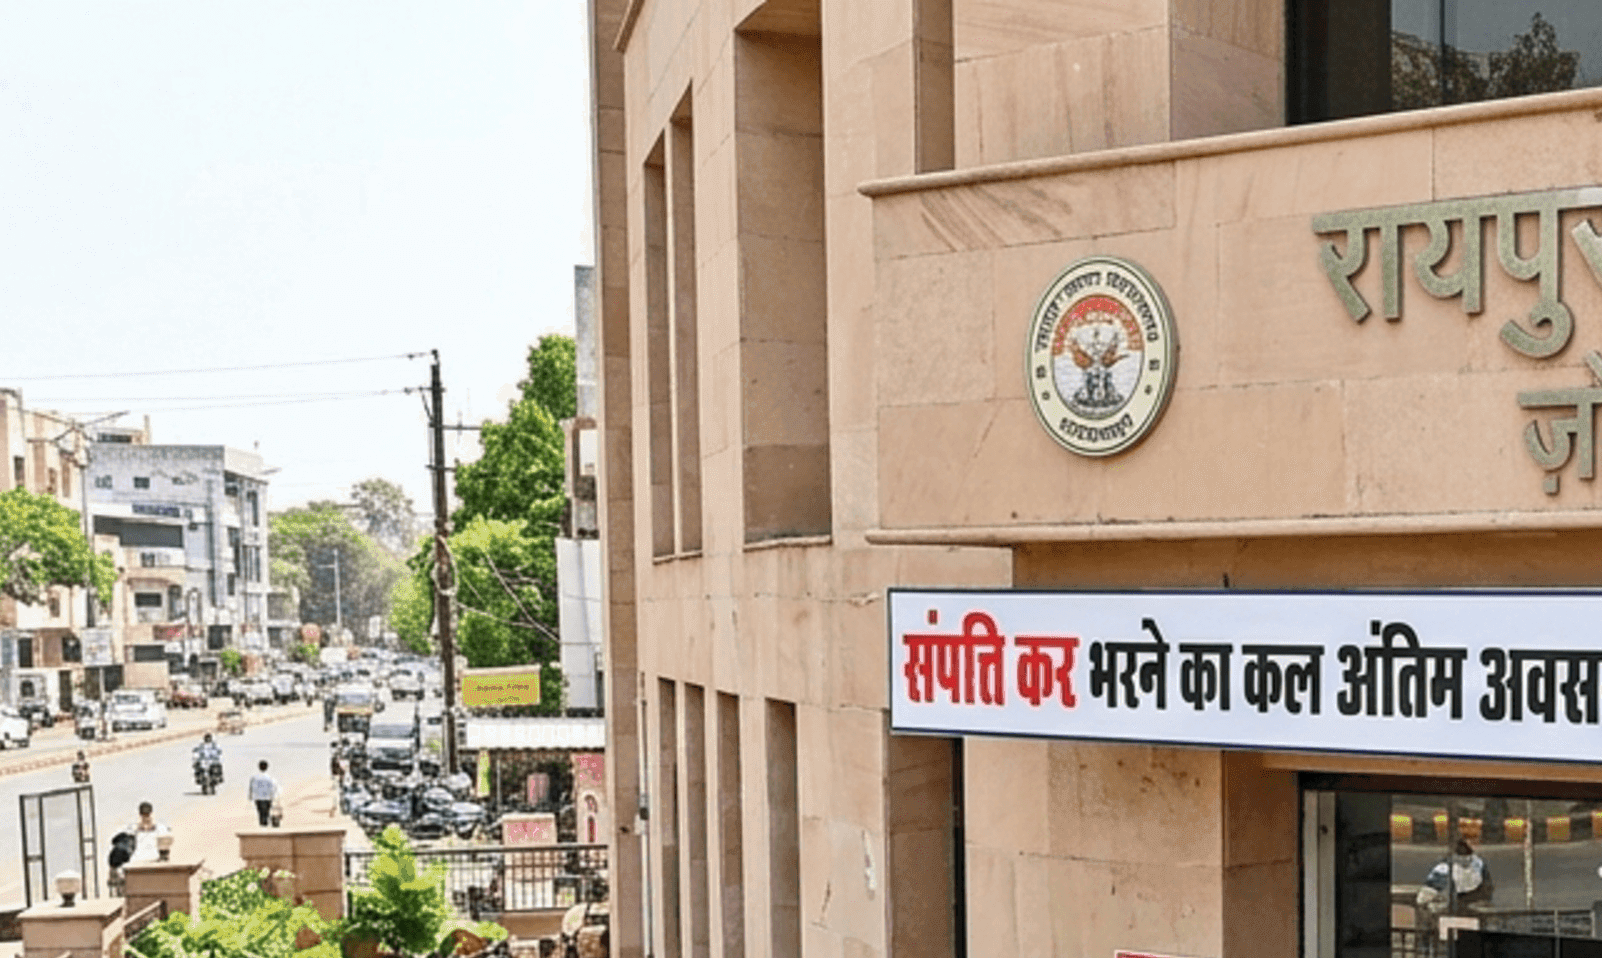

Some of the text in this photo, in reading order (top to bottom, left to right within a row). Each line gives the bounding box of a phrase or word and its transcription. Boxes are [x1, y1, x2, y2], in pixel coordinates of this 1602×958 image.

[1014, 635, 1080, 708] कर
[1089, 618, 1171, 710] भरने
[1178, 643, 1234, 711] का
[1241, 644, 1325, 715] कल
[1337, 620, 1468, 720] अंतिम
